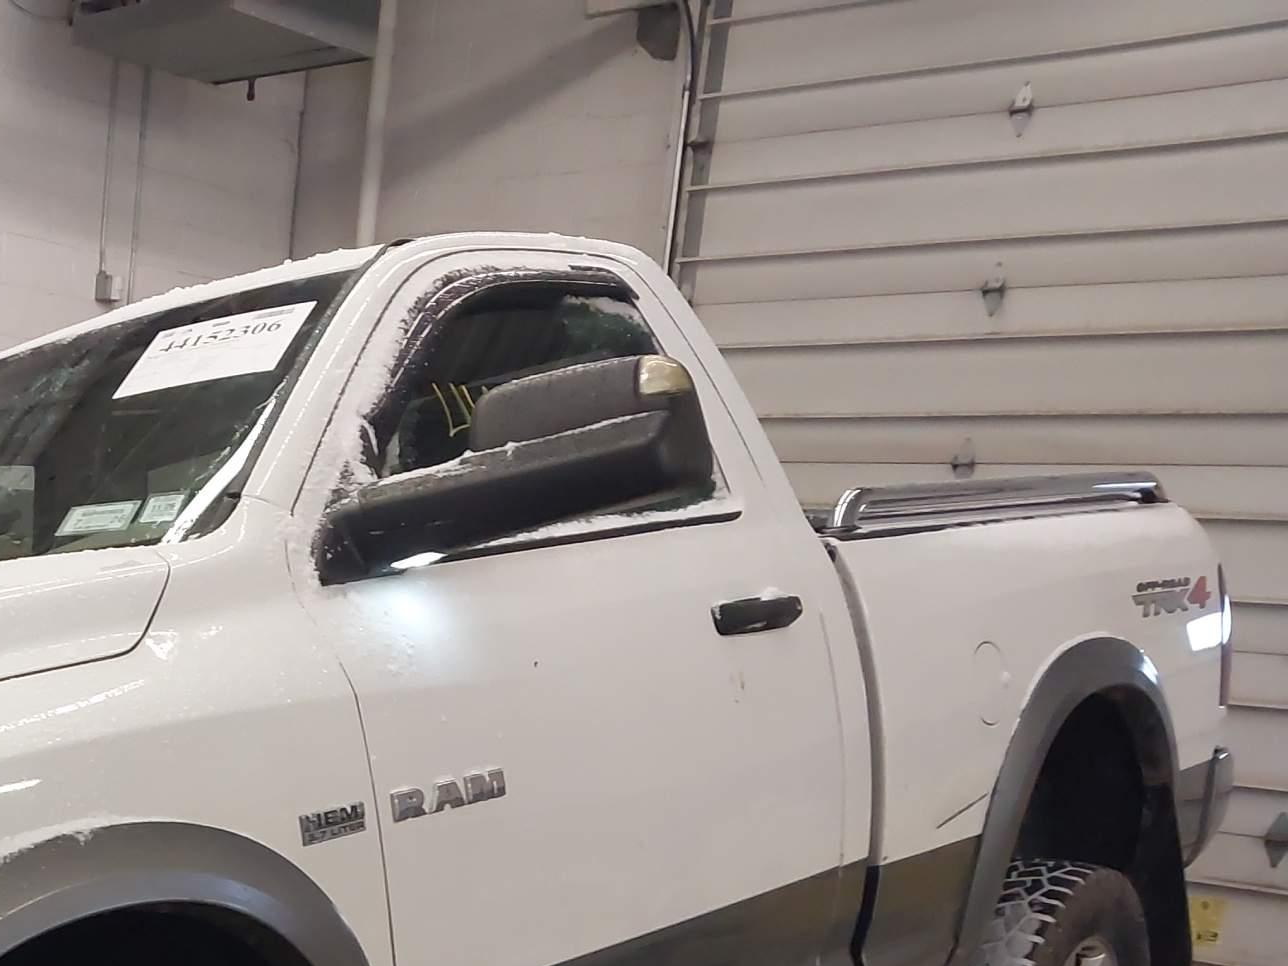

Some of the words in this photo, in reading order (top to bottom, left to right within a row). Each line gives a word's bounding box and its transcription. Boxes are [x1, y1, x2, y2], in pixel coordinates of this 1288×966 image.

[159, 319, 283, 352] 44152306
[389, 767, 506, 823] RAM
[298, 801, 366, 832] HEMI
